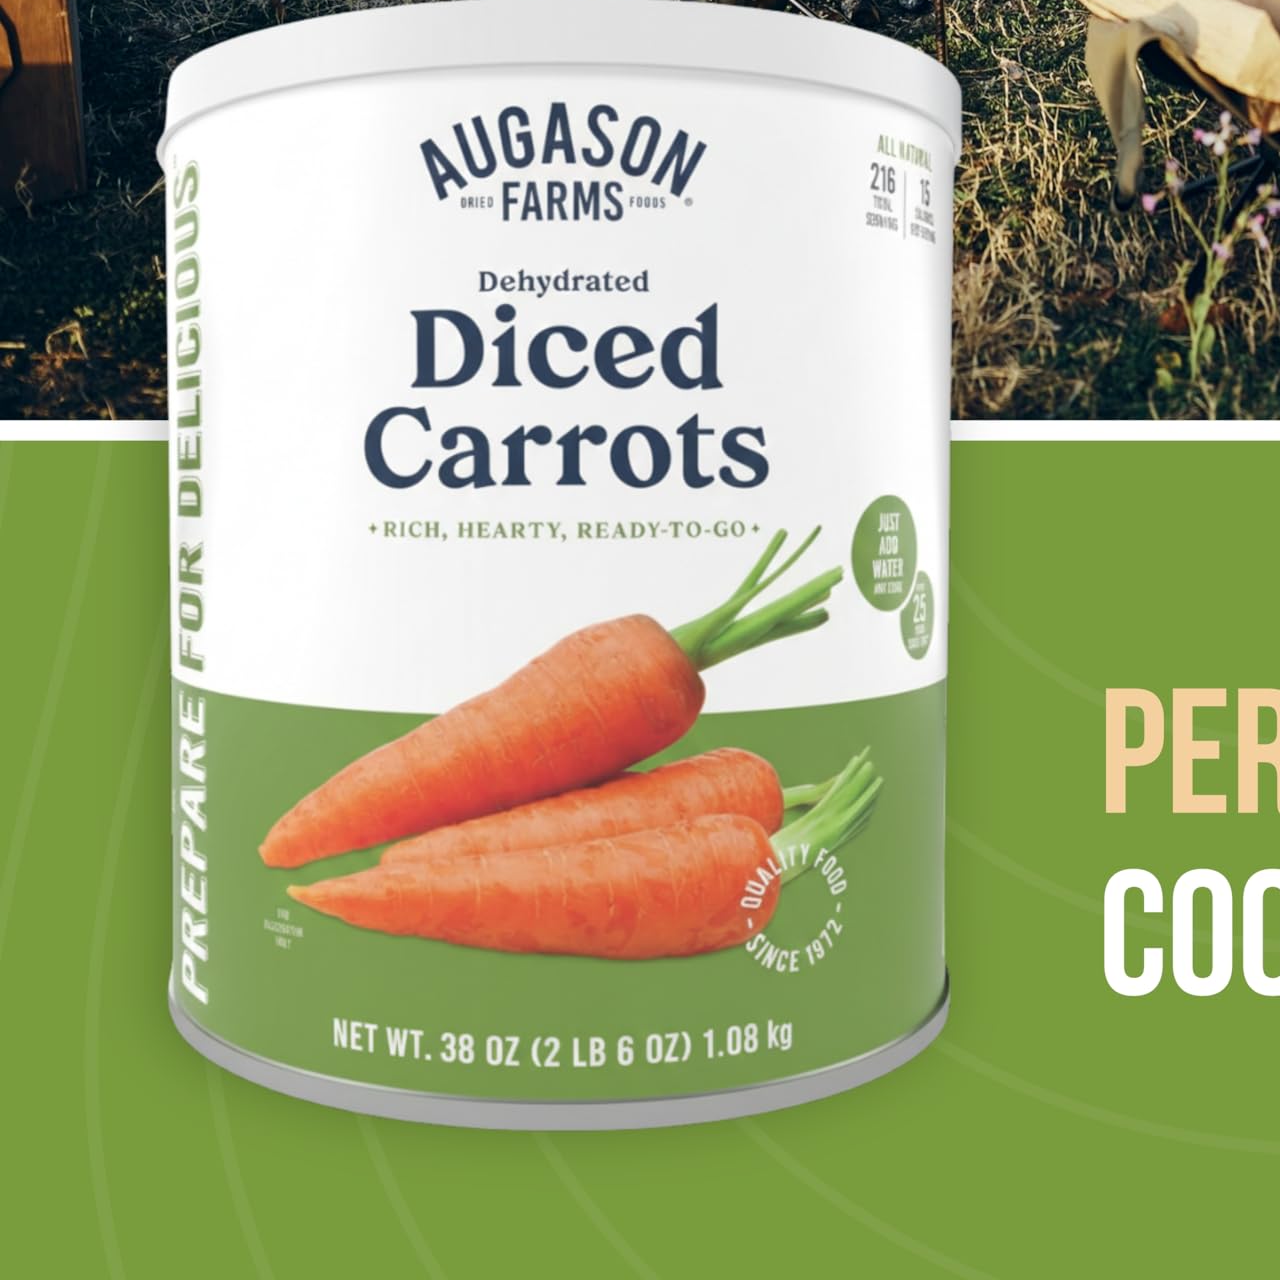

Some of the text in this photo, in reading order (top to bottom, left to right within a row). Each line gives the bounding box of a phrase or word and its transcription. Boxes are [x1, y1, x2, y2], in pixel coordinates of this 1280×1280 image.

[420, 102, 707, 201] AUGASON
[877, 133, 897, 158] ALL
[870, 162, 896, 194] 216
[920, 178, 931, 207] 15
[460, 181, 666, 222] DRIED FARMS FOODS
[478, 269, 649, 298] Dehydrated
[410, 302, 723, 390] Diced
[364, 405, 770, 489] Carrots
[383, 520, 746, 542] RICH, HEARTY, READY-TO-GO
[878, 512, 900, 533] JUST
[879, 536, 899, 555] ADD
[173, 159, 208, 1005] PREPARE FOR DELICIOUS
[872, 558, 904, 579] WATER
[912, 593, 927, 623] 25
[740, 843, 847, 909] QUALITY FOOD
[746, 919, 843, 972] SINCE 1972
[333, 1018, 793, 1068] NET WT. 38 OZ (2 LB 6 OZ) 1.08 kg
